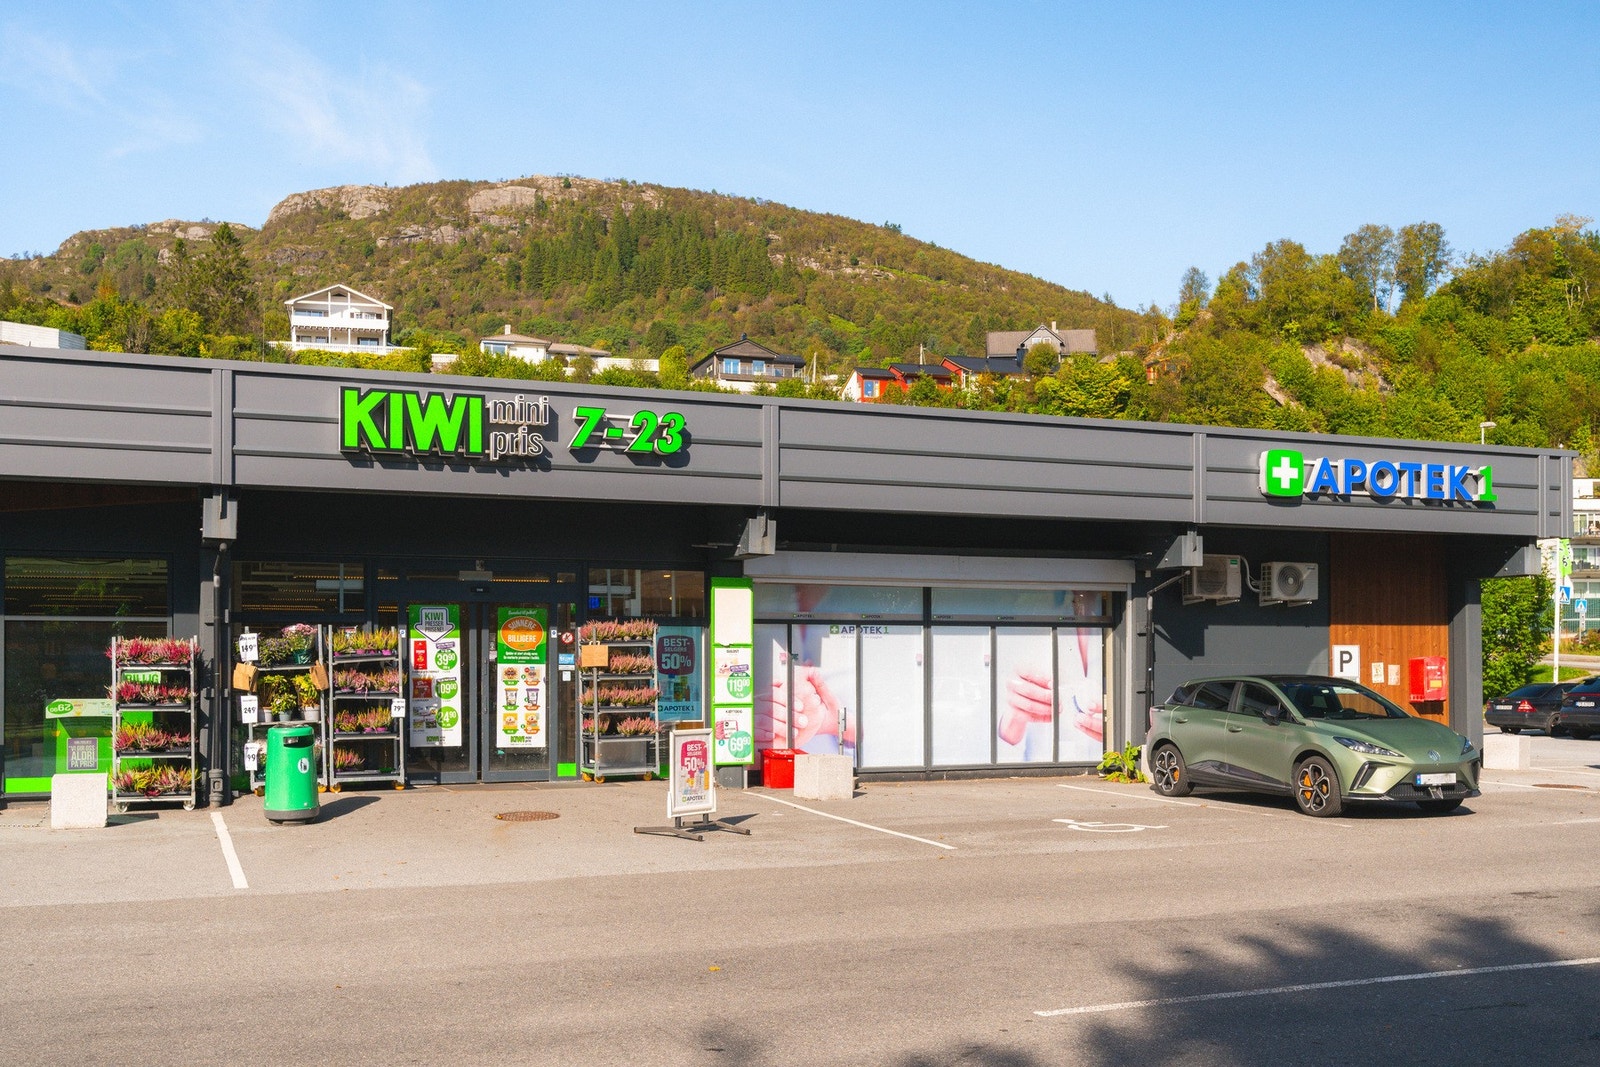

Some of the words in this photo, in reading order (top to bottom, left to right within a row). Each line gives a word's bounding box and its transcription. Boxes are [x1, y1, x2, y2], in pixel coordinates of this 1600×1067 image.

[341, 386, 485, 456] KIWI
[490, 395, 549, 426] mini
[568, 406, 686, 455] 7-23
[490, 427, 544, 461] pris
[1307, 456, 1474, 502] APOTEK
[1477, 465, 1498, 502] 1
[425, 612, 444, 621] KIWI
[507, 634, 537, 643] BILLIGERE
[663, 638, 690, 647] BEST-
[661, 653, 691, 670] 50%
[1340, 650, 1353, 672] P
[71, 751, 95, 761] ALDRI
